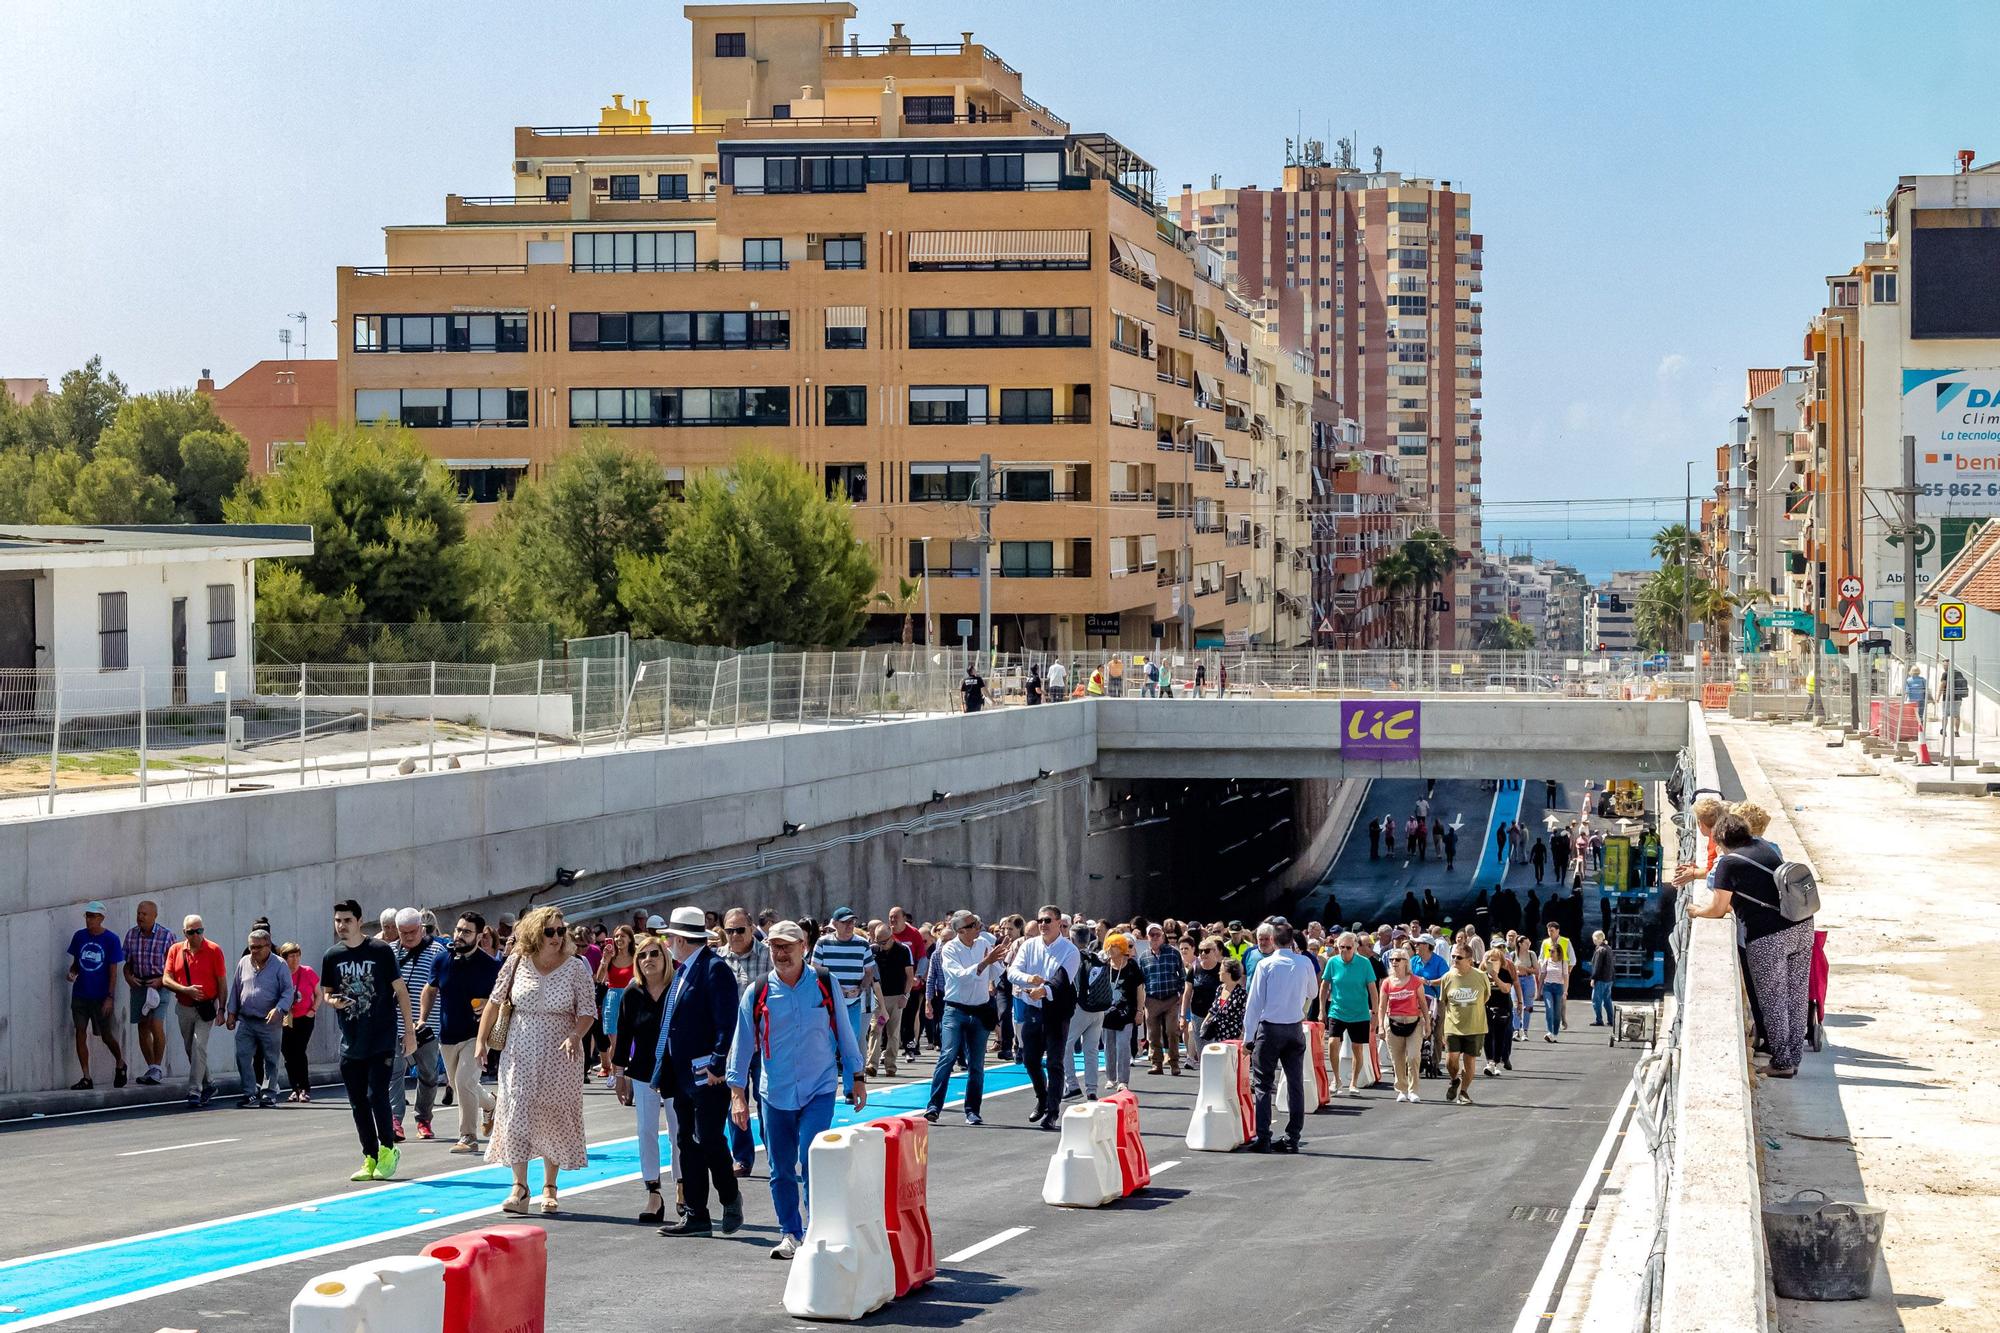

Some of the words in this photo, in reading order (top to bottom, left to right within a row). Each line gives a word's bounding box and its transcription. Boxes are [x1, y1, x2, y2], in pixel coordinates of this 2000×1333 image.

[1941, 430, 1954, 441] La
[1915, 483, 1943, 497] 65
[1949, 483, 1982, 497] 862
[336, 960, 376, 977] TMNT
